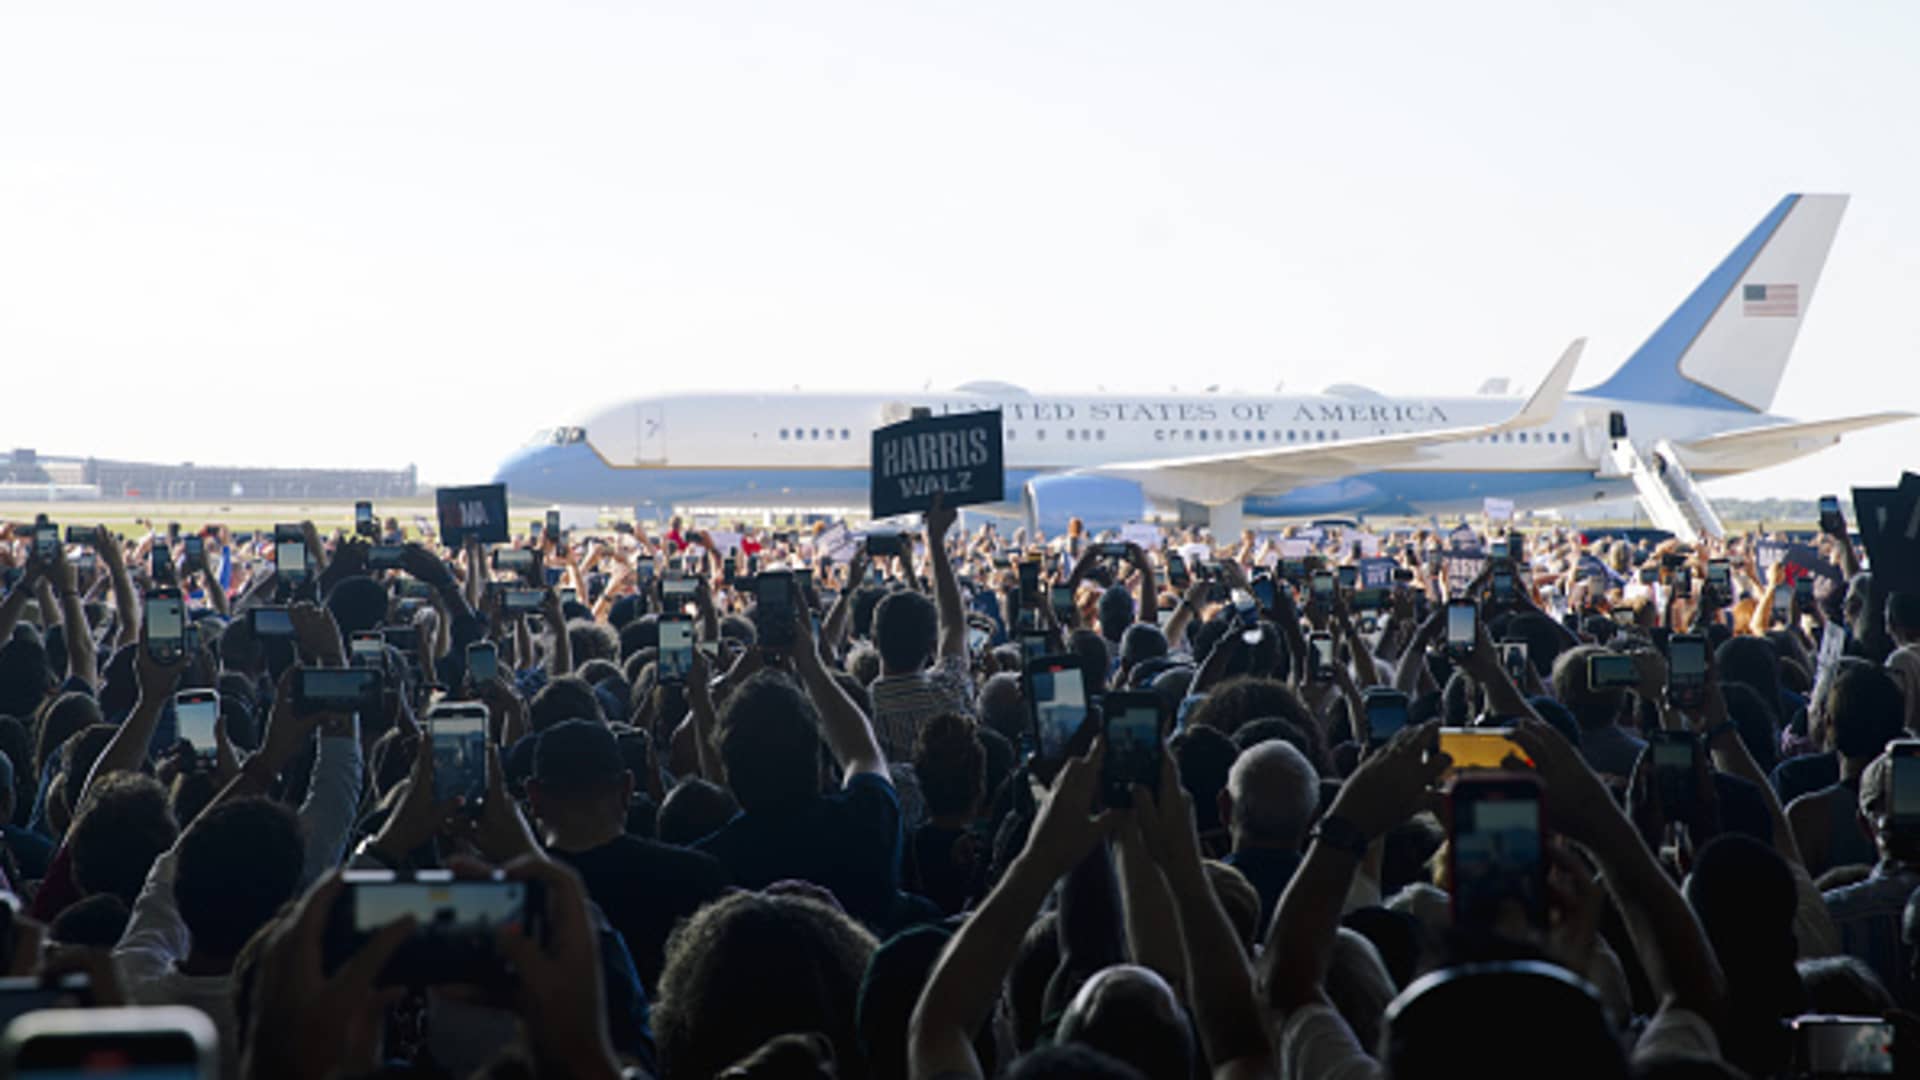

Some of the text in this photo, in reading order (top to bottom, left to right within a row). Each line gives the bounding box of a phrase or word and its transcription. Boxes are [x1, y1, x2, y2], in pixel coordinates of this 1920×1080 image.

[943, 402, 1449, 422] UTED STATES OF AMERICA
[882, 427, 988, 477] HARRIS
[898, 471, 974, 498] WALZ
